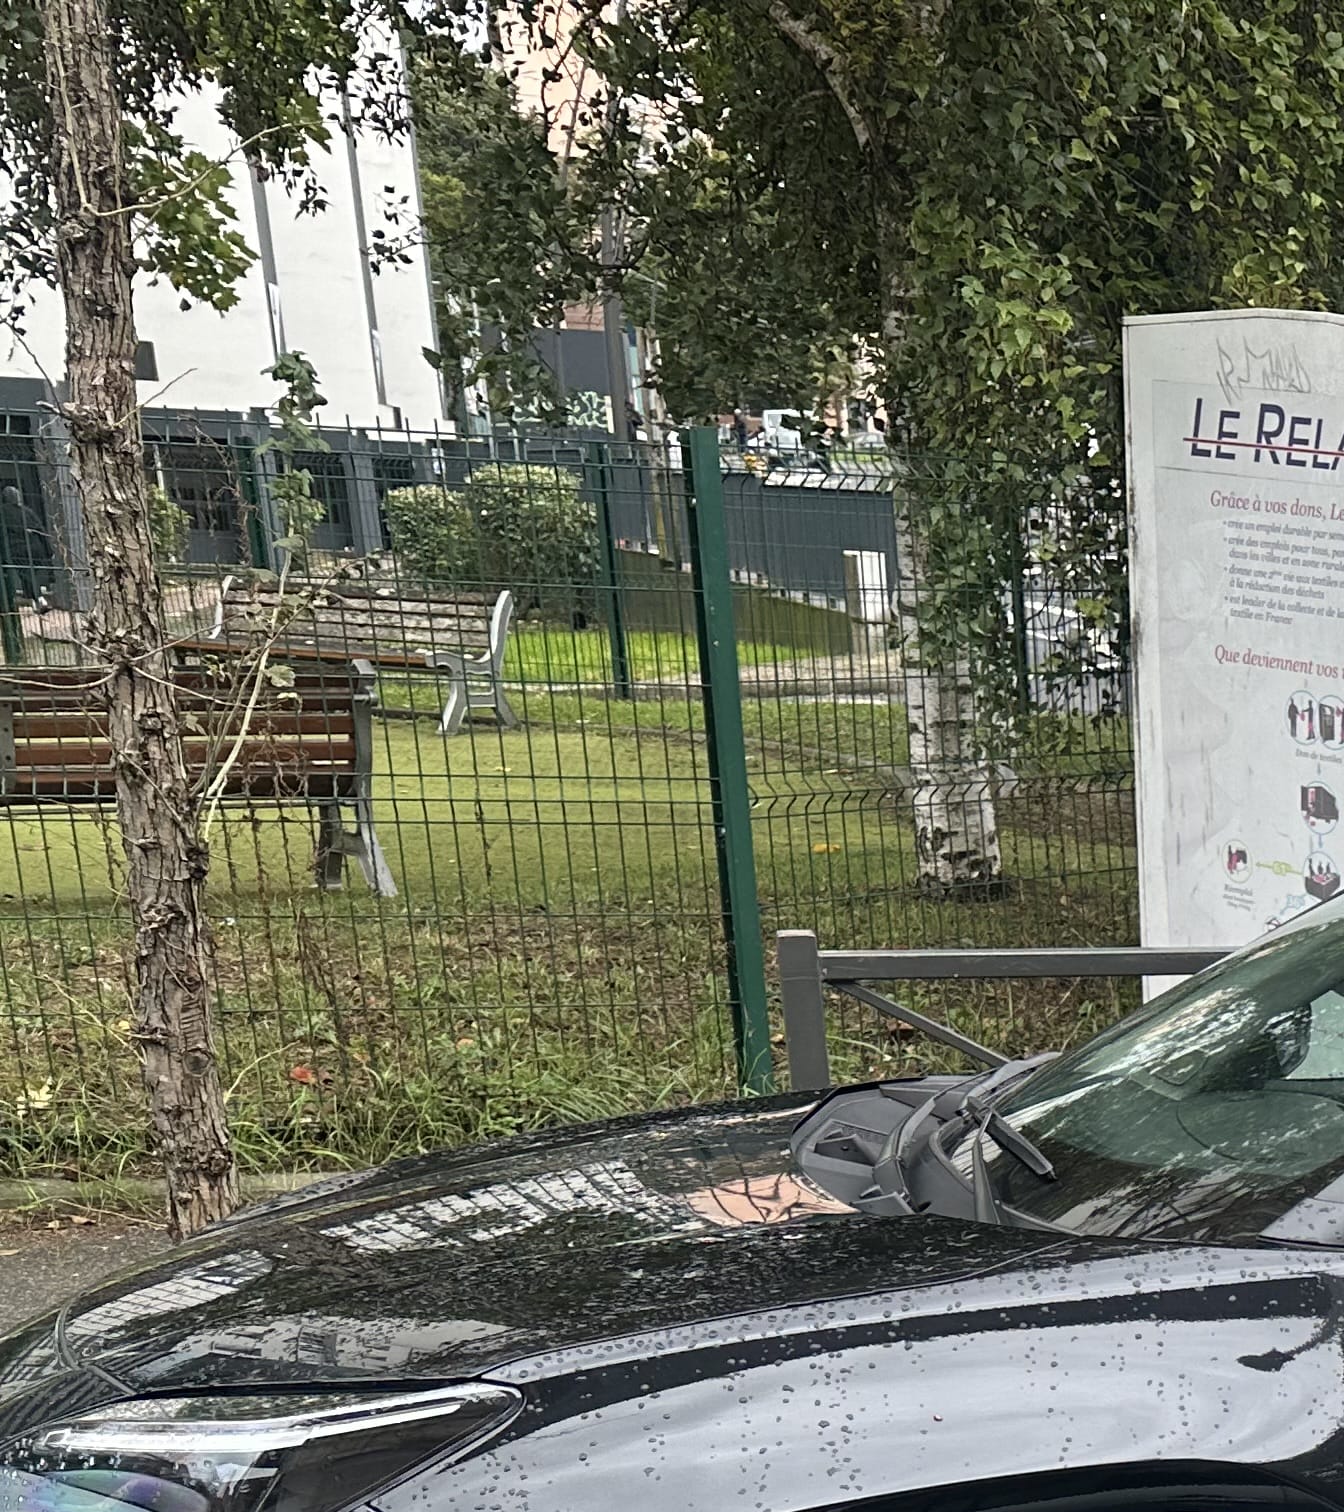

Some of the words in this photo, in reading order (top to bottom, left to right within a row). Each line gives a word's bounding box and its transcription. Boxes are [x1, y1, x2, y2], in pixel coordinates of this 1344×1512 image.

[1190, 398, 1240, 460] LE
[1210, 490, 1249, 510] Grâce
[1252, 493, 1260, 511] à
[1264, 499, 1287, 515] vos
[1290, 497, 1327, 521] dons,
[1215, 644, 1240, 664] Que
[1242, 648, 1313, 674] deviennent
[1316, 664, 1339, 679] vos
